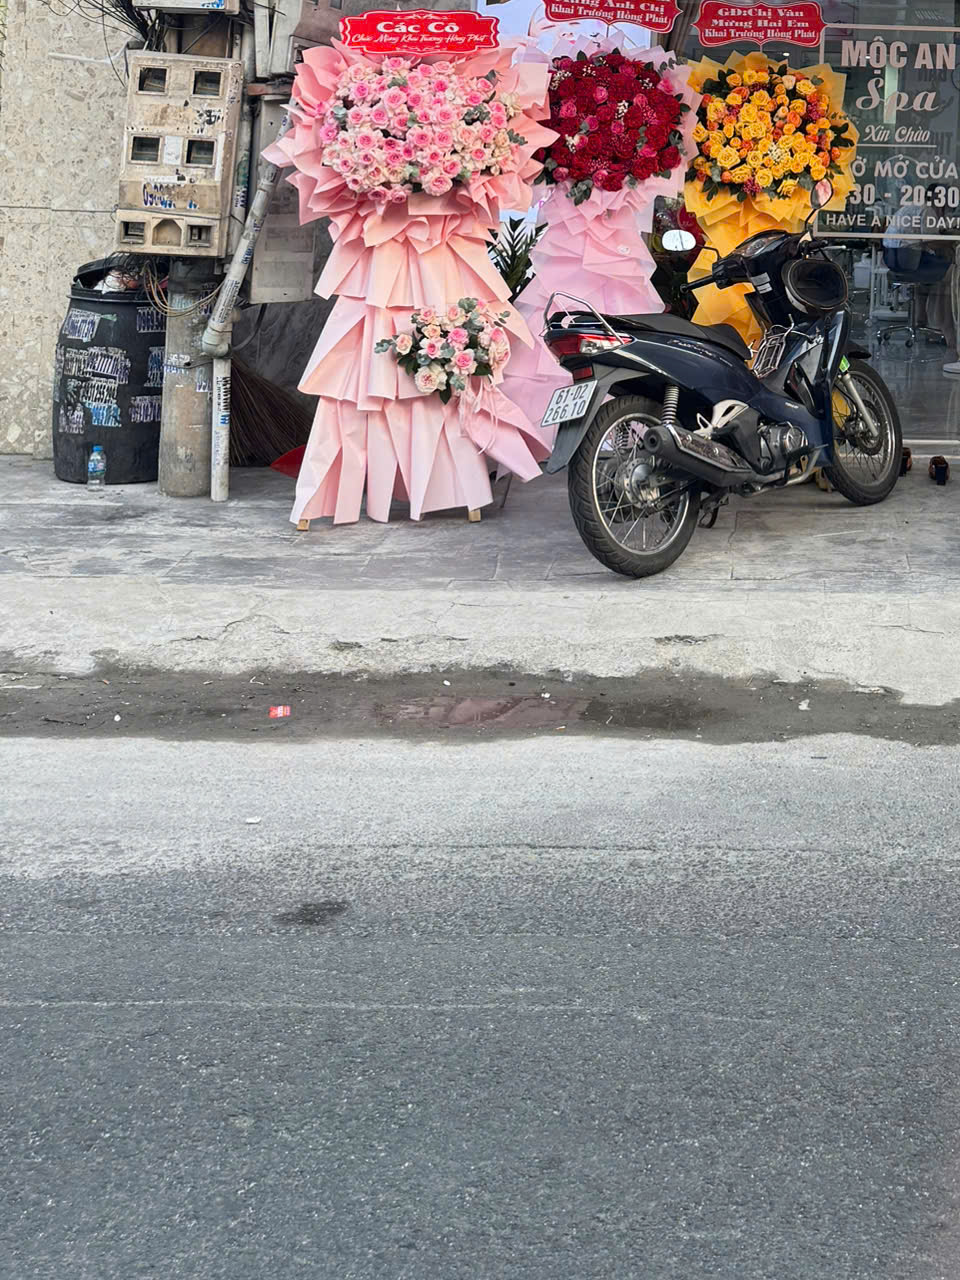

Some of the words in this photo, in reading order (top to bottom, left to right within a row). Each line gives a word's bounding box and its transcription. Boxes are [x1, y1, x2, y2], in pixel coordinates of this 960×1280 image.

[551, 4, 574, 14] Khai
[577, 6, 614, 20] Trương
[646, 13, 668, 24] Phát
[605, 0, 635, 10] Anh
[640, 2, 665, 14] Chị
[377, 21, 421, 33] Các
[427, 21, 460, 33] Cô
[711, 19, 753, 29] Mừng
[704, 29, 727, 37] Khai
[729, 29, 765, 39] Trương
[794, 29, 816, 38] Phát
[841, 36, 908, 74] MỘC
[914, 43, 957, 70] AN
[856, 77, 939, 122] Spa
[863, 124, 890, 142] Xin
[895, 125, 931, 142] Chào
[874, 154, 909, 178] MỞ
[915, 156, 959, 179] CỬA
[900, 185, 960, 208] 20:30
[826, 214, 867, 227] HAVE
[871, 216, 882, 227] A
[886, 216, 921, 228] NICE
[926, 216, 960, 229] DAY!
[544, 400, 586, 423] 266.10
